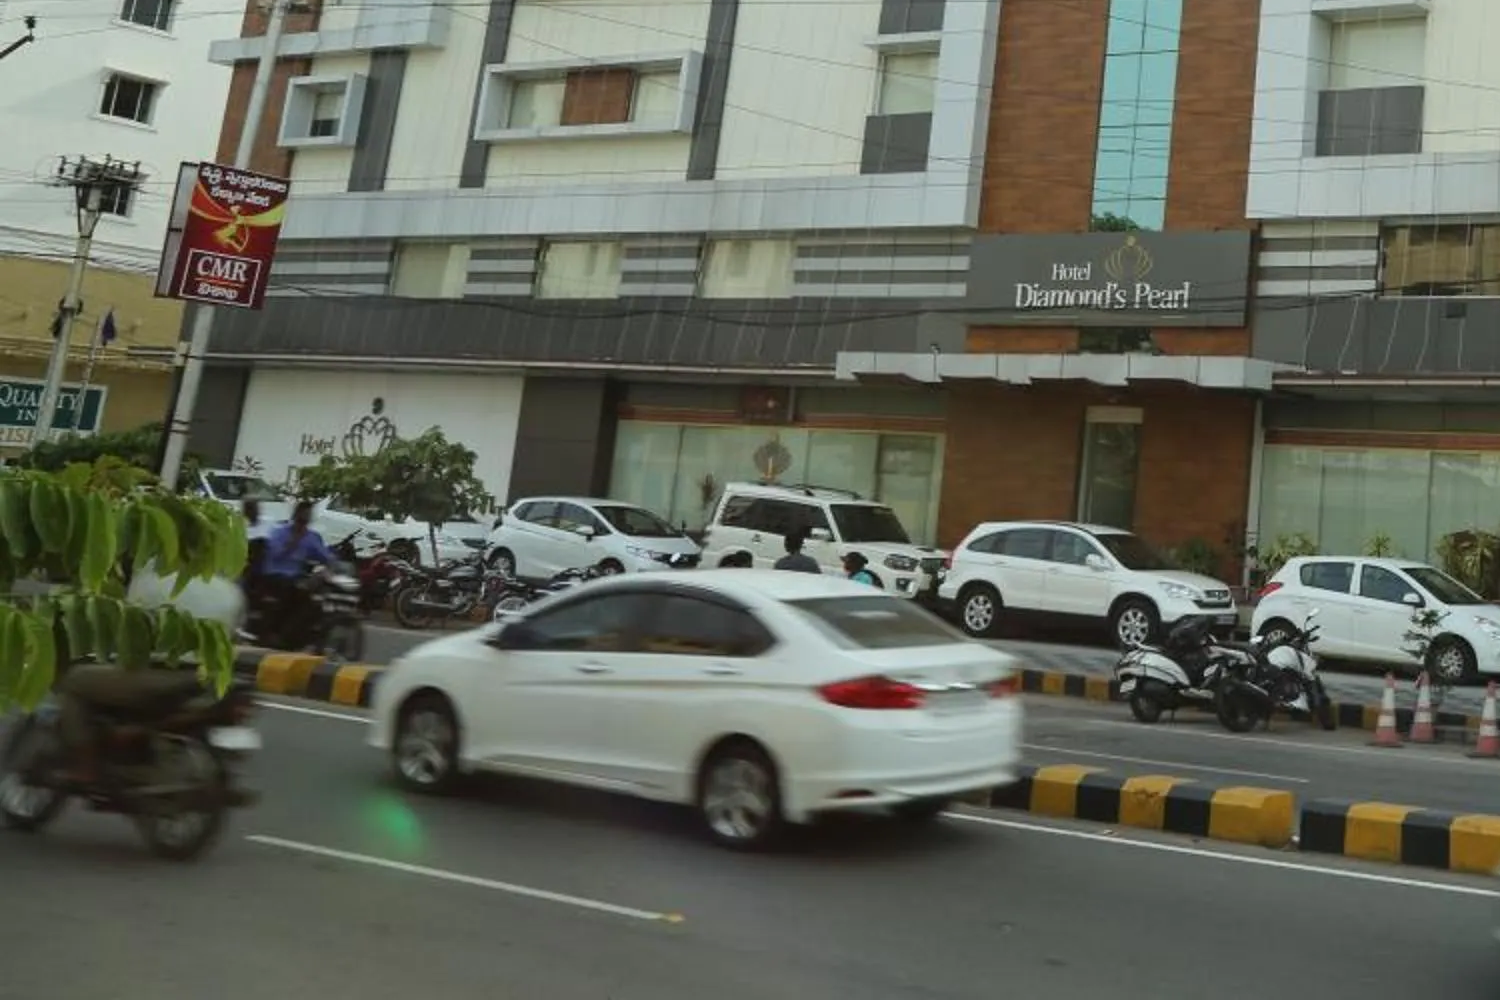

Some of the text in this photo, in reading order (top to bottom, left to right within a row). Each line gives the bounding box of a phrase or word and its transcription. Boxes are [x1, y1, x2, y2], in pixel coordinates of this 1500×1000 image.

[197, 255, 247, 283] CMR
[1051, 261, 1093, 281] Hotel
[1014, 281, 1192, 309] Diamond's Pearl
[0, 383, 82, 411] QUATY
